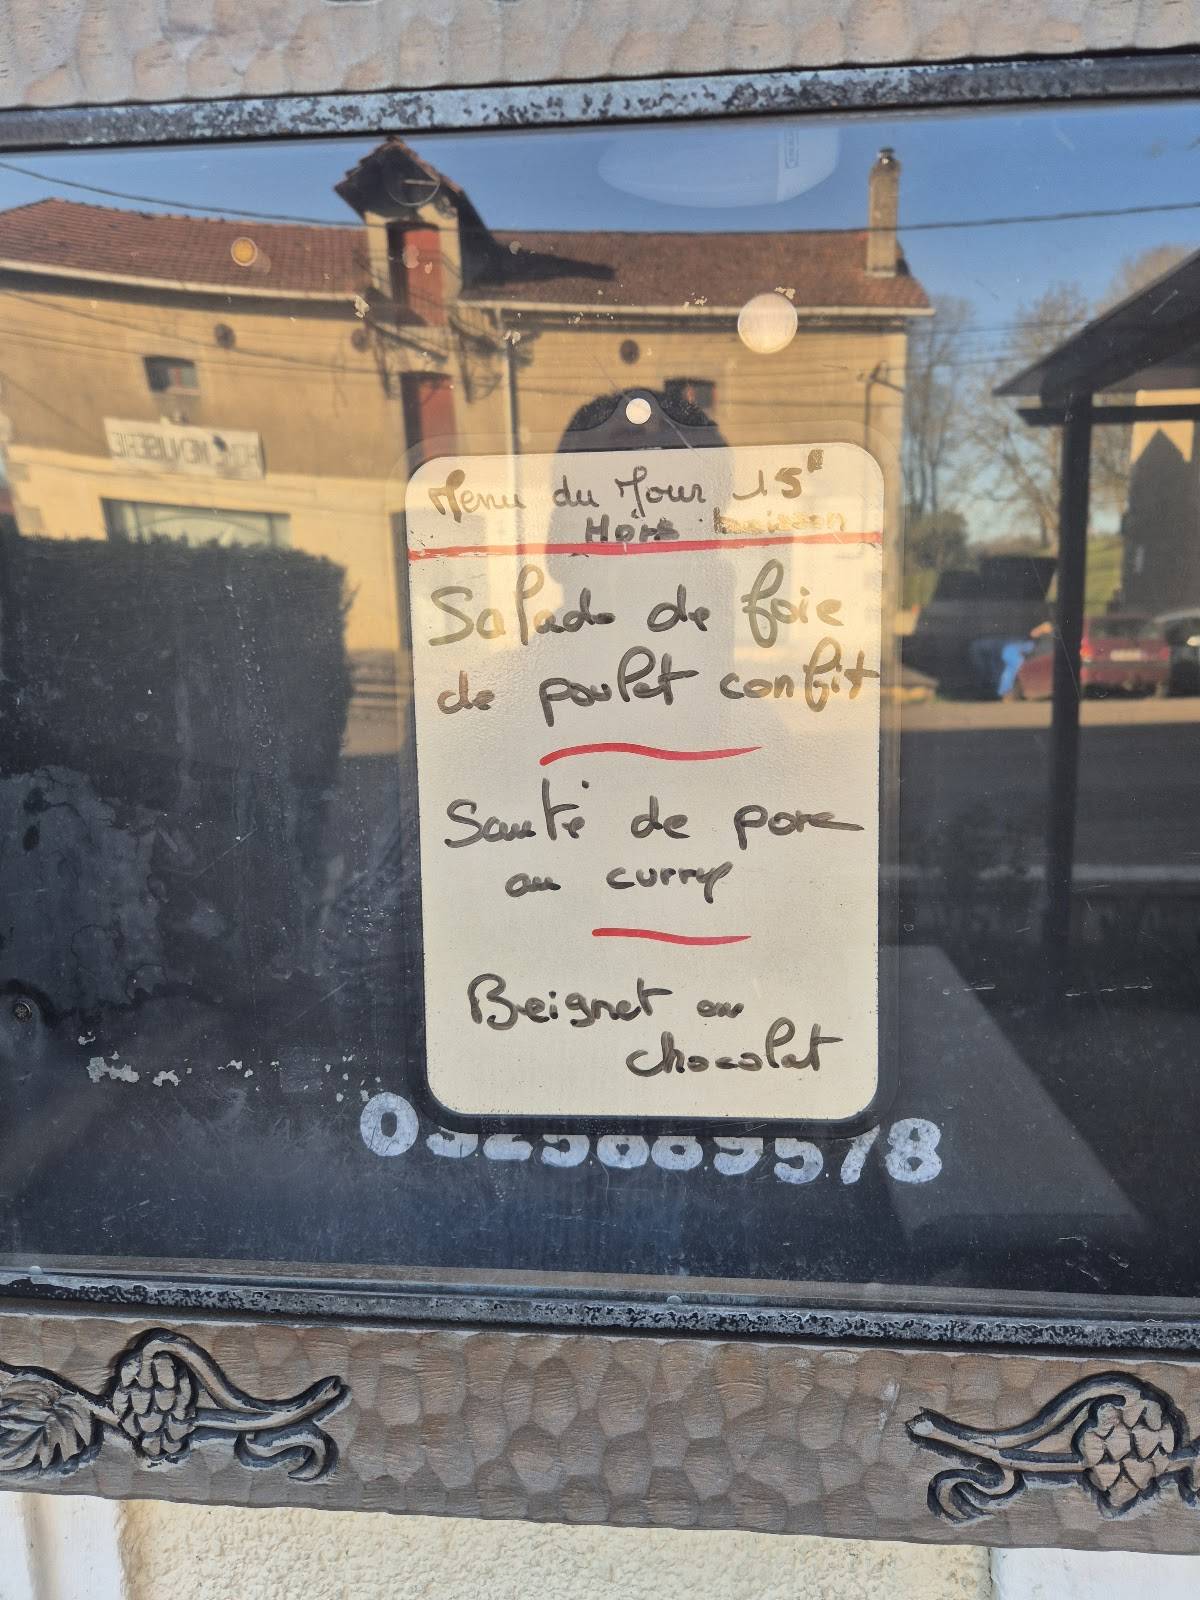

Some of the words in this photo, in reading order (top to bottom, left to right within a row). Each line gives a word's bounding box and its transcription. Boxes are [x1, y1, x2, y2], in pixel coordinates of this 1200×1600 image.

[428, 469, 526, 523] Menu
[552, 474, 599, 508] du
[615, 465, 706, 517] Jour
[428, 564, 616, 646] Salade
[647, 583, 711, 632] de
[742, 558, 844, 648] foie
[437, 670, 496, 714] de
[539, 645, 699, 727] poulet
[720, 636, 880, 713] confit
[444, 777, 589, 848] Sauté
[631, 795, 690, 839] de
[733, 804, 864, 850] porc
[505, 872, 561, 898] au
[606, 861, 733, 903] curry
[468, 973, 673, 1031] Beignet
[697, 999, 744, 1018] au
[626, 1017, 843, 1078] chocolat
